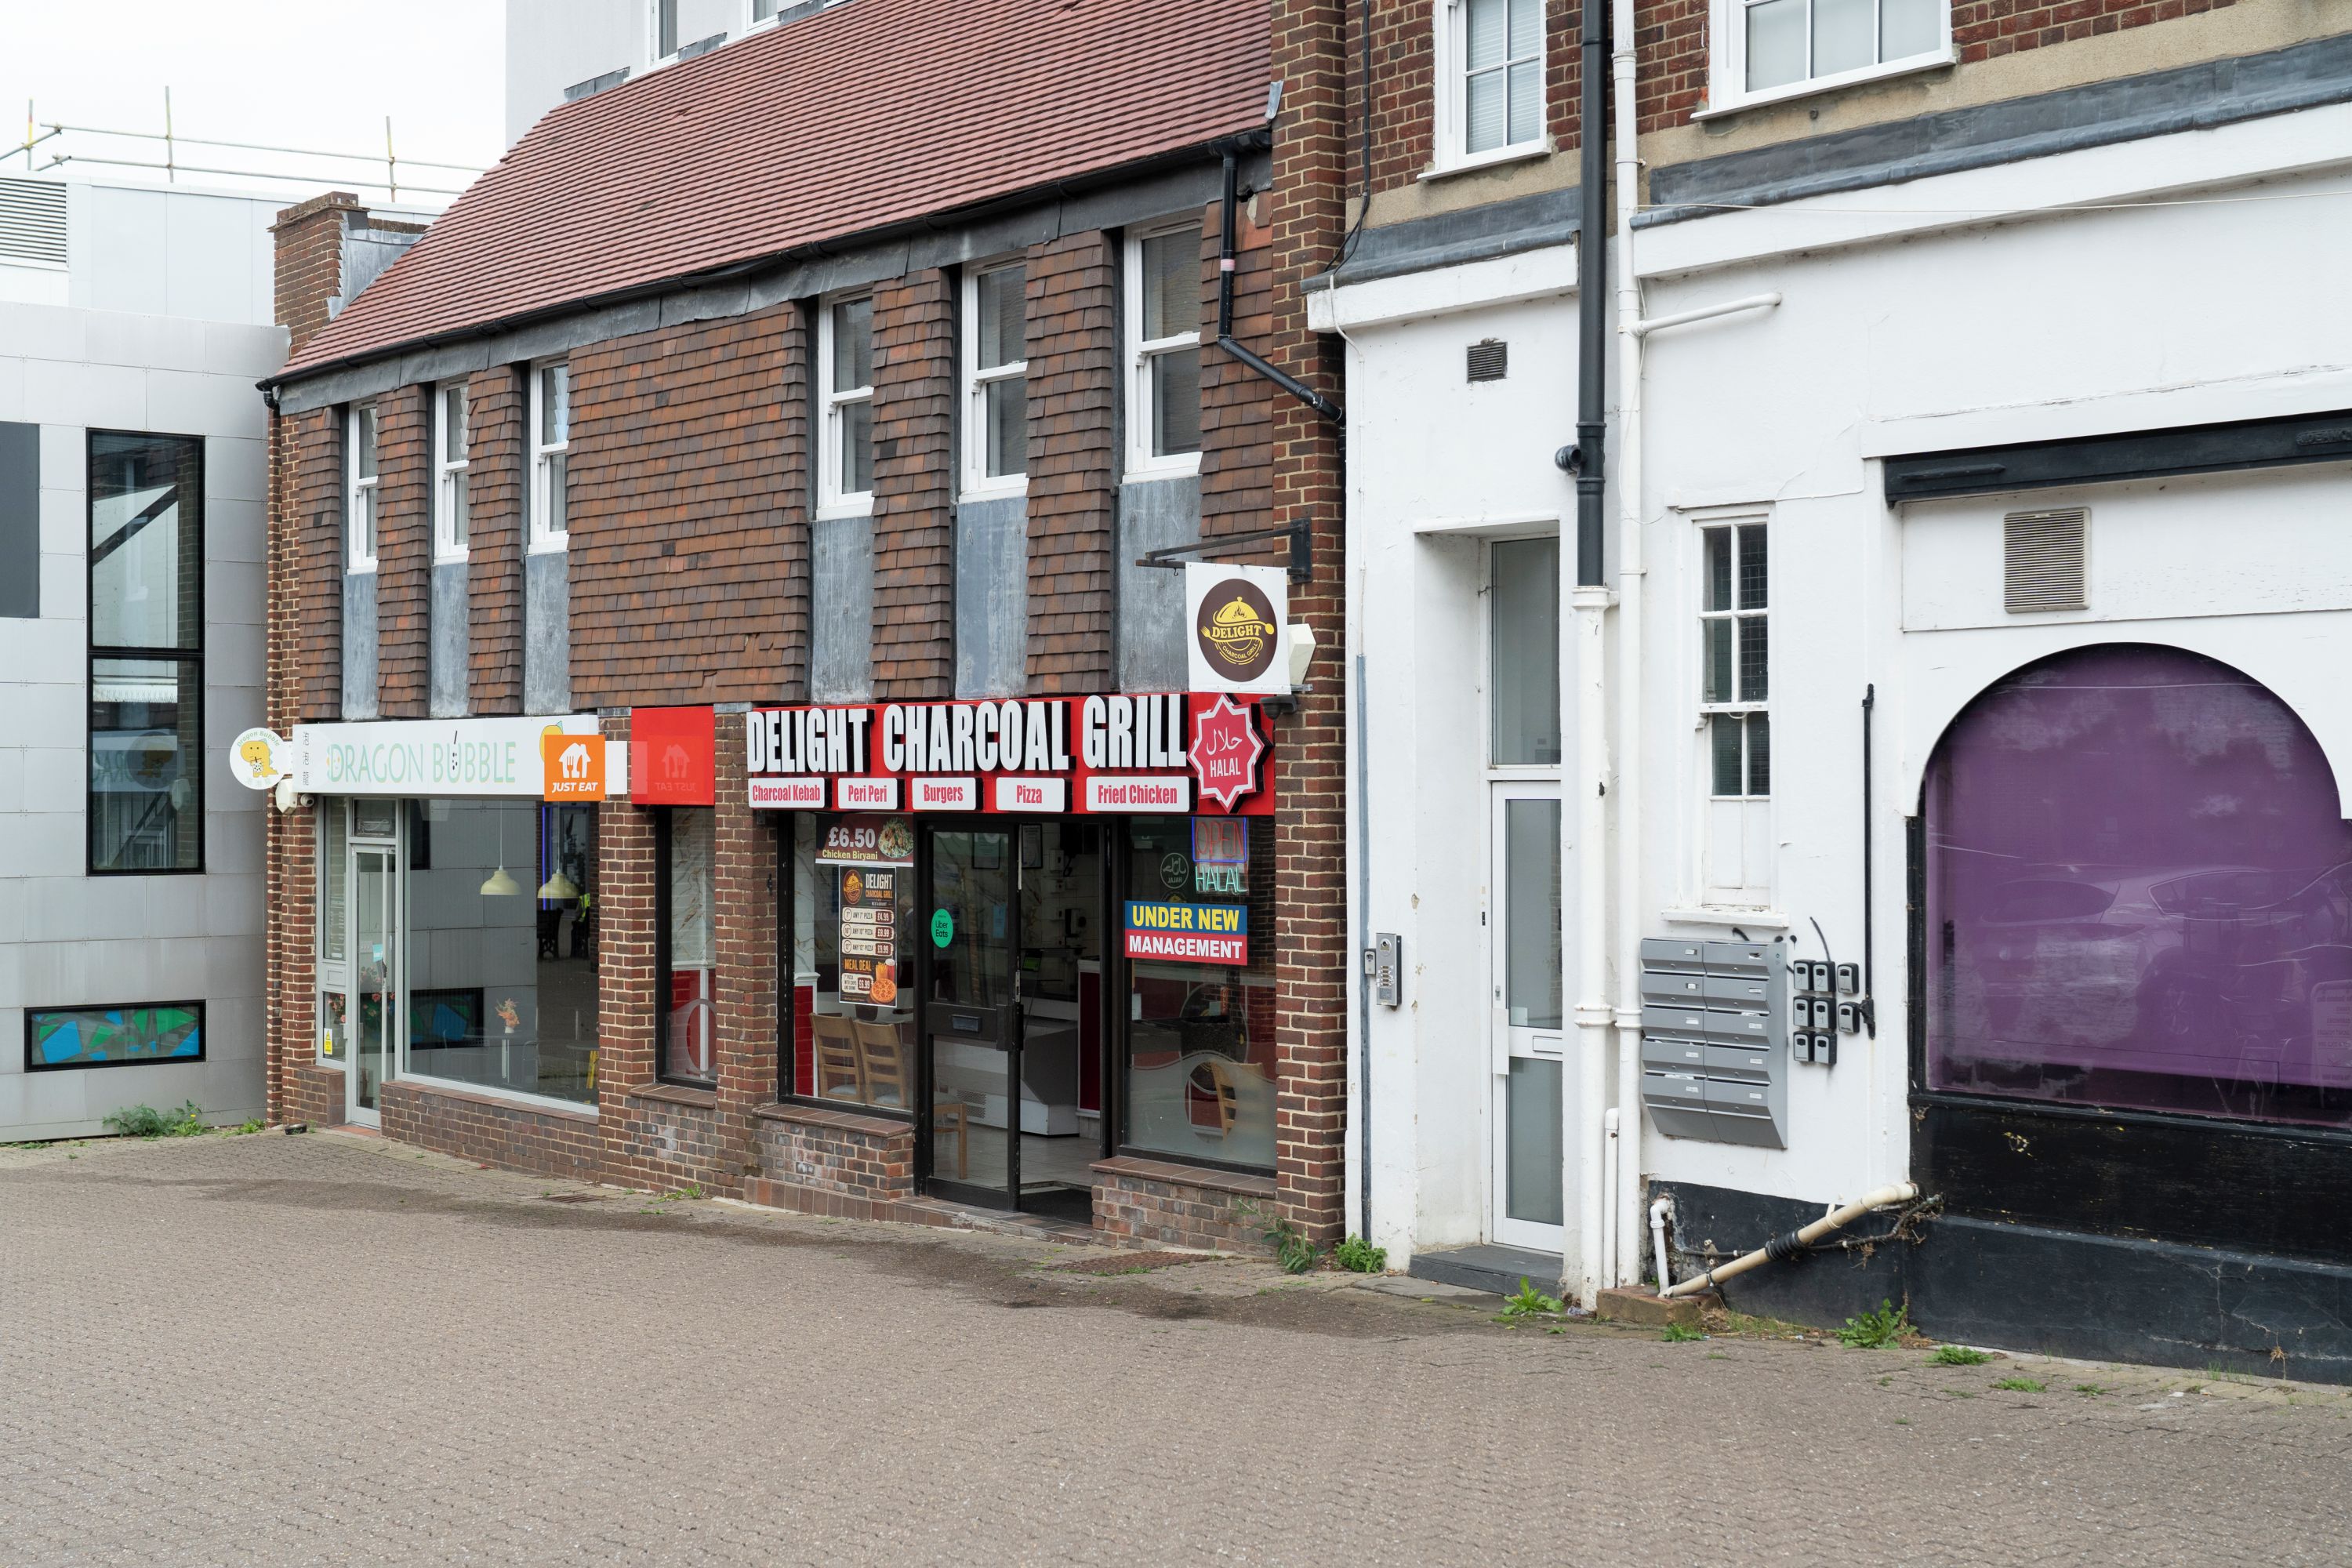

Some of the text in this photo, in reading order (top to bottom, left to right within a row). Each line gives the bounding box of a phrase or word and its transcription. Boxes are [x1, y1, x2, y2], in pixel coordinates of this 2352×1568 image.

[1211, 624, 1262, 639] DELIGHT
[1222, 642, 1258, 659] CHARCOAL GRILL
[237, 731, 280, 747] Dragon Bubble
[746, 693, 1187, 773] DELIGHT CHARCOAL GRILL
[1206, 727, 1243, 756] حلال
[328, 742, 517, 783] DRAGON BUBBLE
[1210, 757, 1241, 778] HALAL
[552, 782, 598, 793] JUST EAT
[752, 784, 821, 803] Charcoal Kebab
[848, 785, 887, 802] Peri Peri
[924, 784, 964, 804] Burgers
[1016, 785, 1043, 804] Pizza
[1098, 785, 1178, 804] Fried Chicken
[828, 826, 876, 848] £6.50
[1195, 821, 1244, 858] OPEN
[822, 850, 878, 861] Chicken Biryani
[866, 873, 893, 890] DELIGHT
[1195, 865, 1249, 893] HALAL
[865, 890, 883, 898] CHARCOAL
[883, 890, 893, 898] GRILL
[935, 920, 948, 929] Uber
[1133, 906, 1240, 931] UNDER NEW
[935, 929, 949, 938] Eats
[1129, 935, 1243, 959] MANAGEMENT
[844, 959, 872, 971] MEAL DEAL
[1817, 978, 1824, 987] 2
